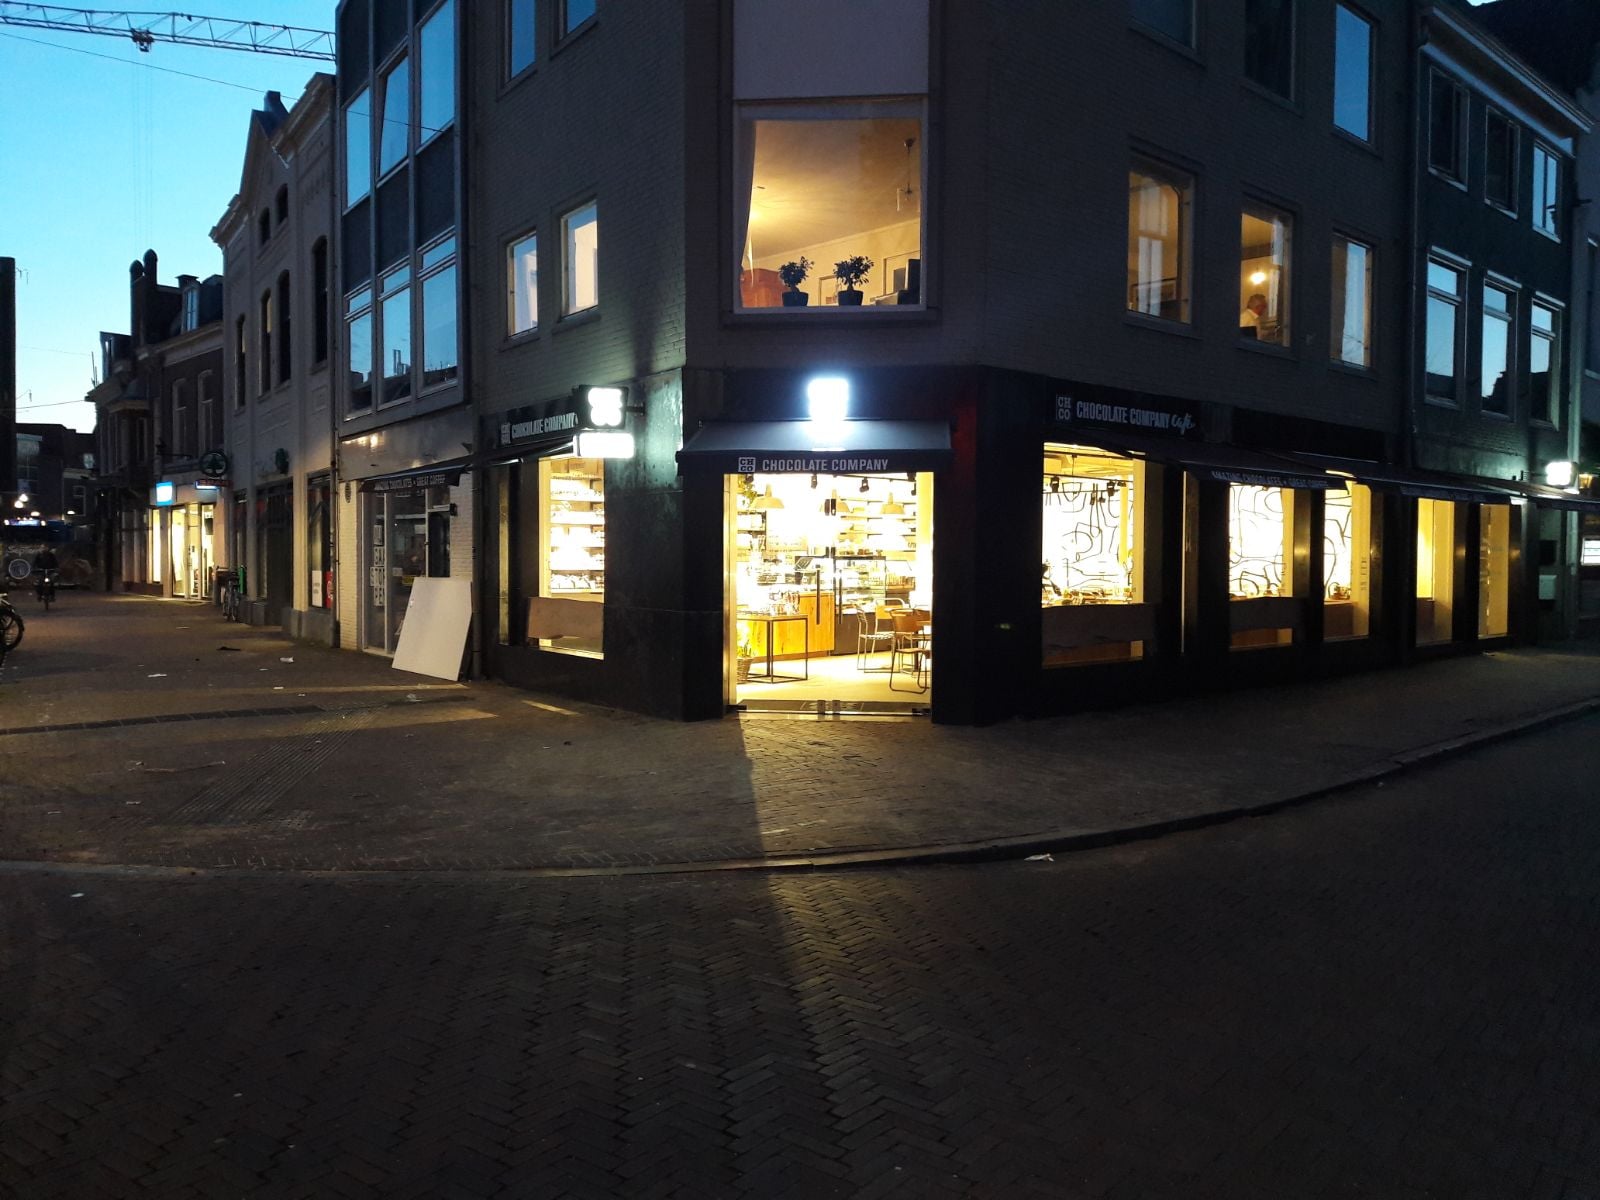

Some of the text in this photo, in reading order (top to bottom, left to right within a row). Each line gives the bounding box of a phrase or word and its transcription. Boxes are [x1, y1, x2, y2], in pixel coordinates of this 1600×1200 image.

[1057, 396, 1072, 409] CH
[1057, 409, 1071, 421] CO
[1076, 400, 1128, 424] CHOCOLATE
[1130, 407, 1171, 429] COMPANY
[544, 412, 575, 433] COMPANY
[740, 457, 755, 465] CH
[762, 458, 889, 472] CHOCOLATE COMPANY
